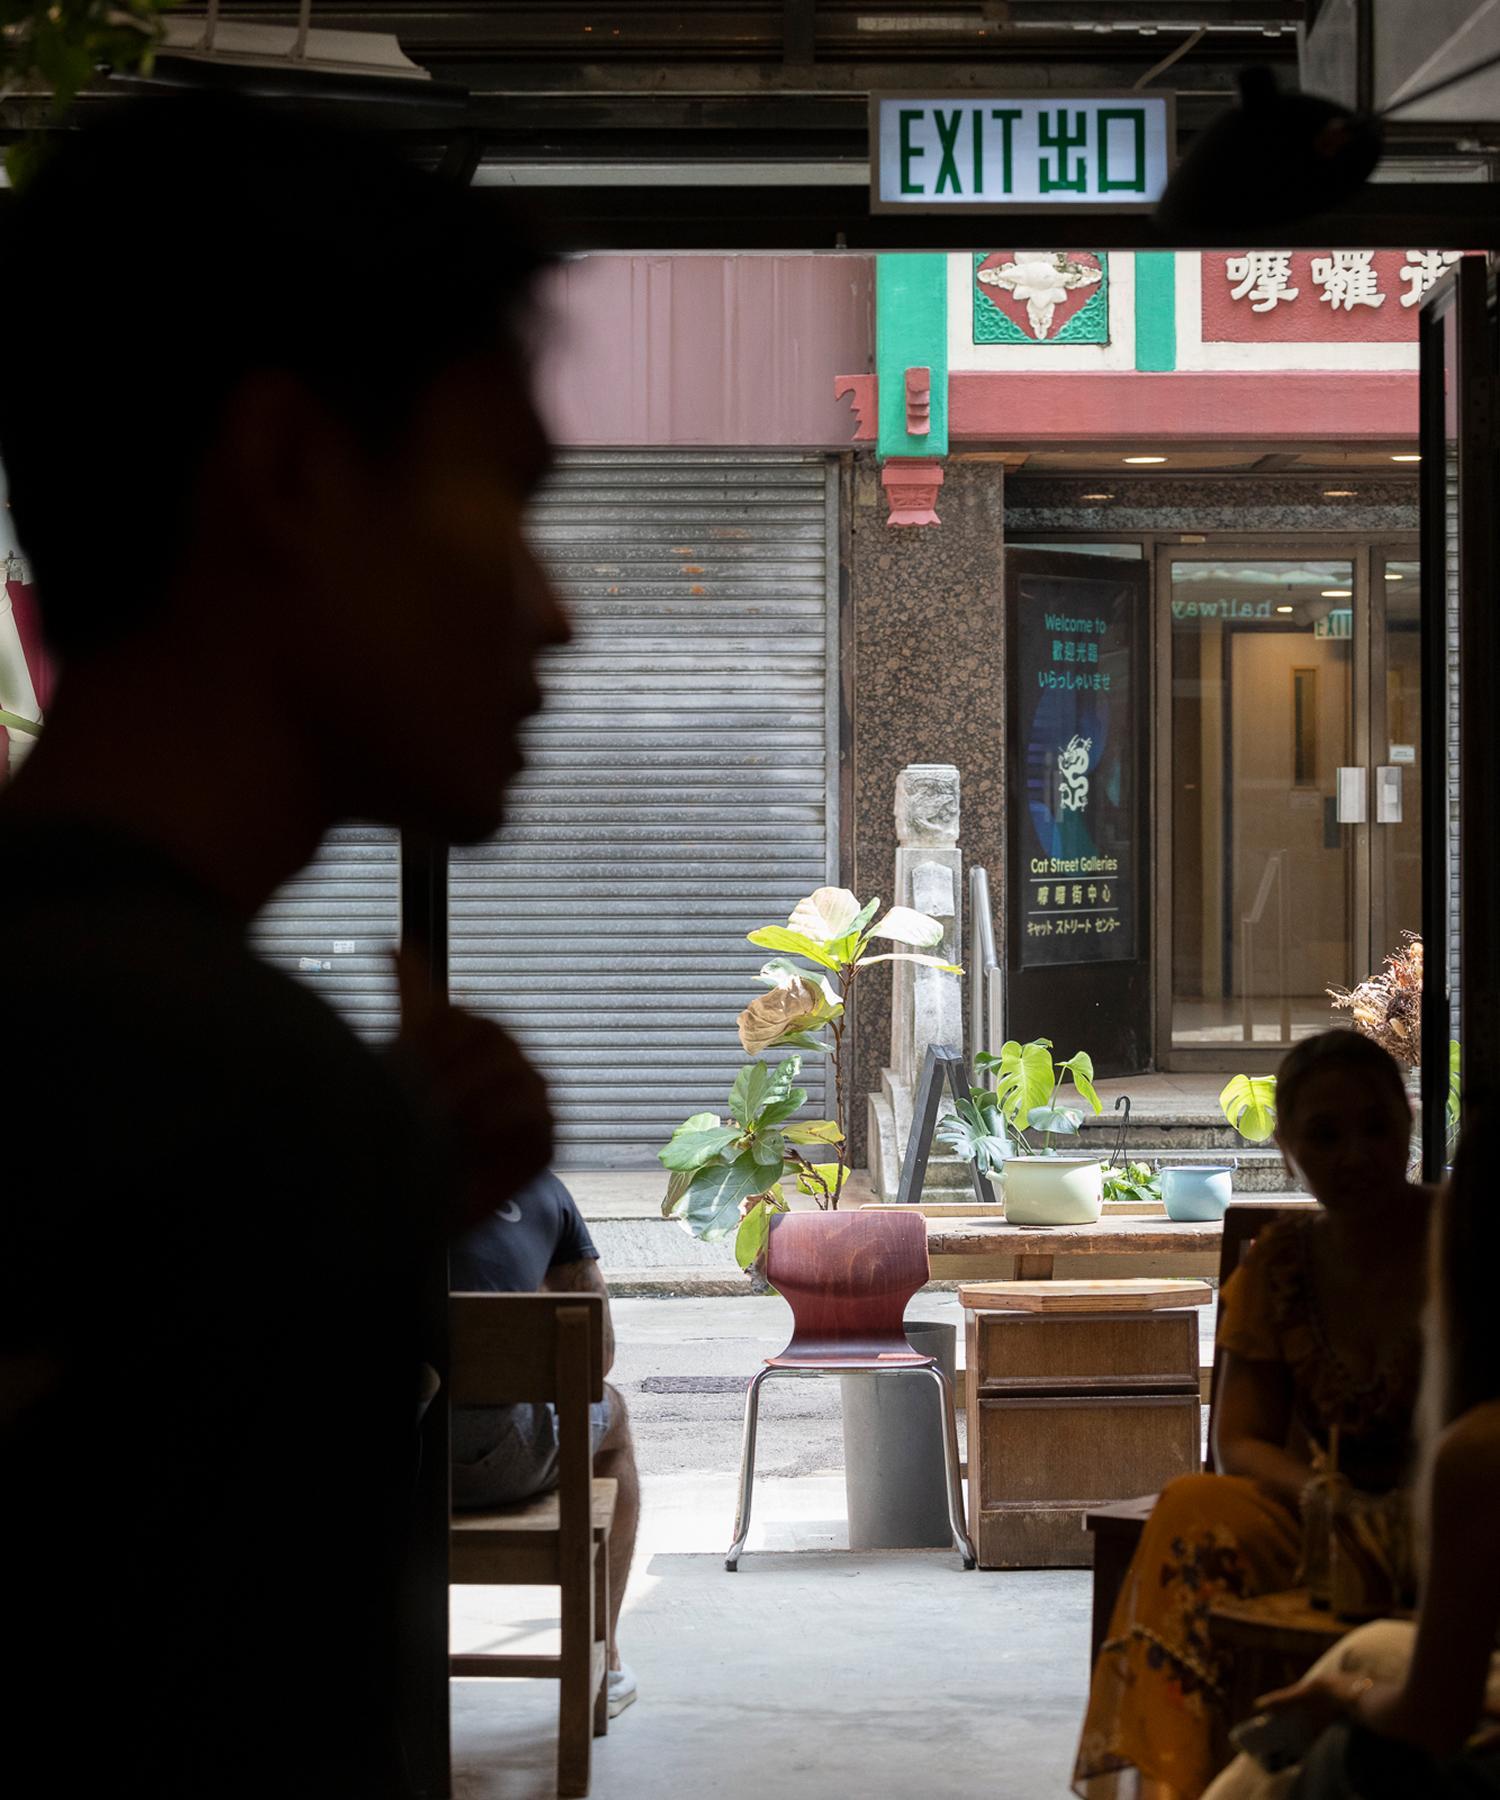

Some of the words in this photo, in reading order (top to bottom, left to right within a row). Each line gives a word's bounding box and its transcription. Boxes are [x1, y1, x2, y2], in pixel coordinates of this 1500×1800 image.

[899, 107, 1022, 195] EXIT
[1038, 107, 1147, 195] 出口
[1044, 612, 1093, 633] Welcome
[1095, 617, 1106, 634] to
[1052, 639, 1098, 663] 歡迎光臨
[1038, 670, 1111, 691] いらっしゃいませ
[1031, 858, 1049, 873] Cat
[1050, 856, 1079, 873] Street
[1080, 855, 1118, 872] Galleries
[1027, 920, 1053, 936] キャット
[1056, 919, 1092, 934] ストリート
[1095, 917, 1120, 933] センター
